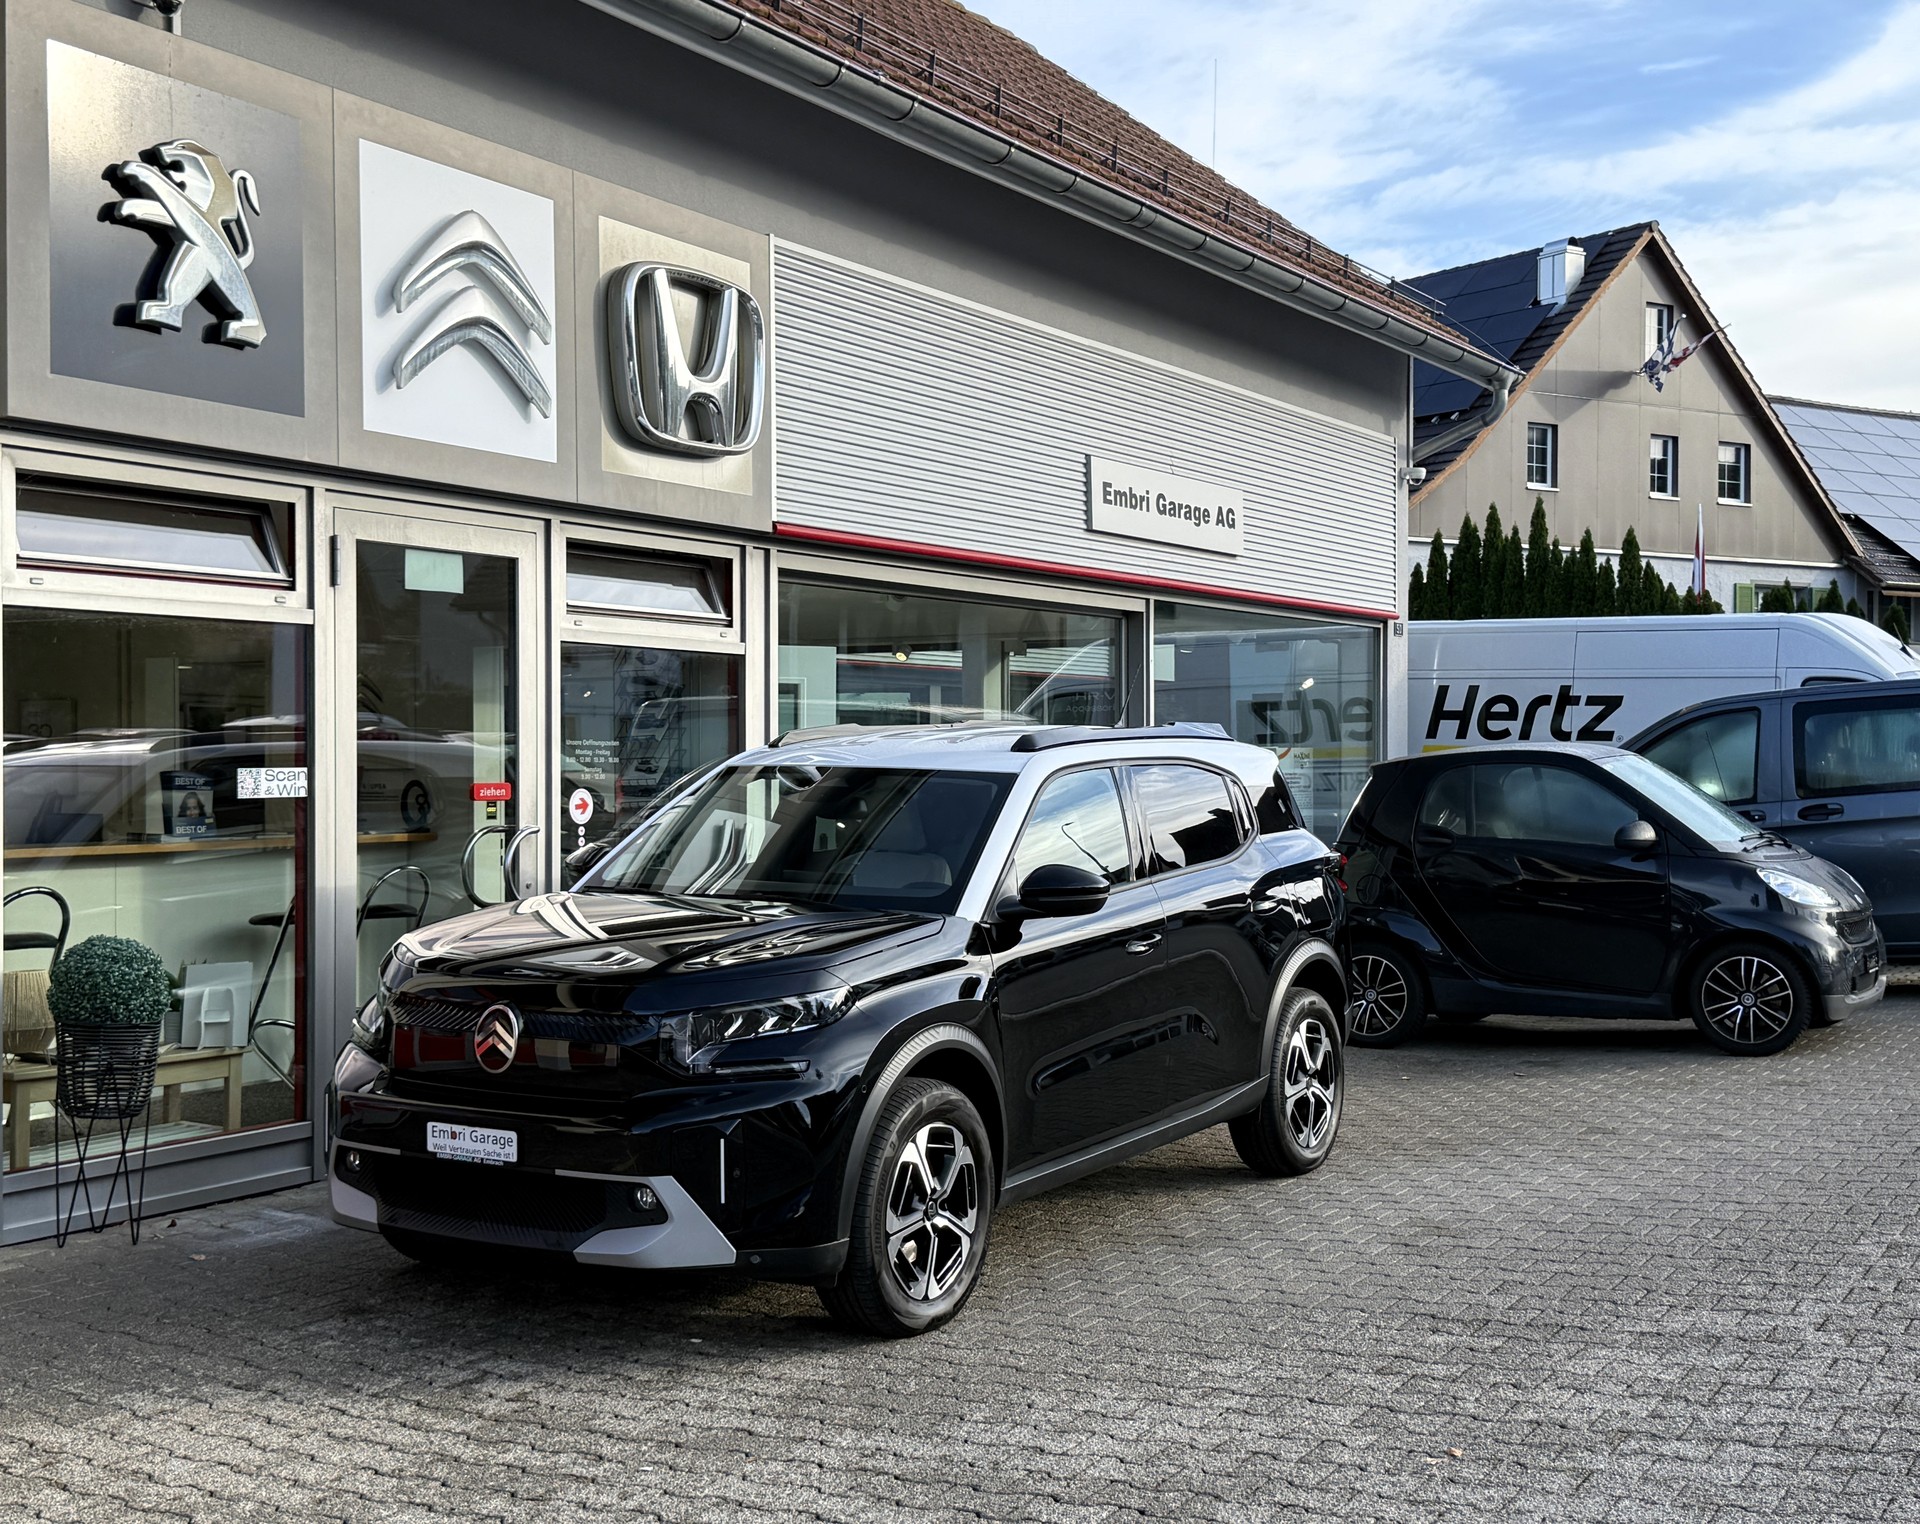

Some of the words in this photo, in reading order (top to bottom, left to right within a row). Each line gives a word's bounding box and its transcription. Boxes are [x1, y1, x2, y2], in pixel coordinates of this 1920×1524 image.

[1102, 481, 1150, 512] Embri
[1155, 492, 1211, 527] Garage
[1215, 505, 1236, 530] AG
[1425, 684, 1624, 742] Hertz
[175, 777, 194, 785] BEST
[264, 769, 307, 782] Scan
[264, 786, 275, 796] &
[276, 782, 308, 796] Win
[479, 787, 506, 797] ziehen
[175, 825, 195, 834] BEST
[196, 825, 207, 833] OF
[431, 1125, 466, 1142] Embri
[469, 1129, 514, 1150] Garage
[432, 1142, 447, 1151] Weil
[448, 1144, 482, 1155] Vertrauen
[482, 1148, 502, 1158] Sache
